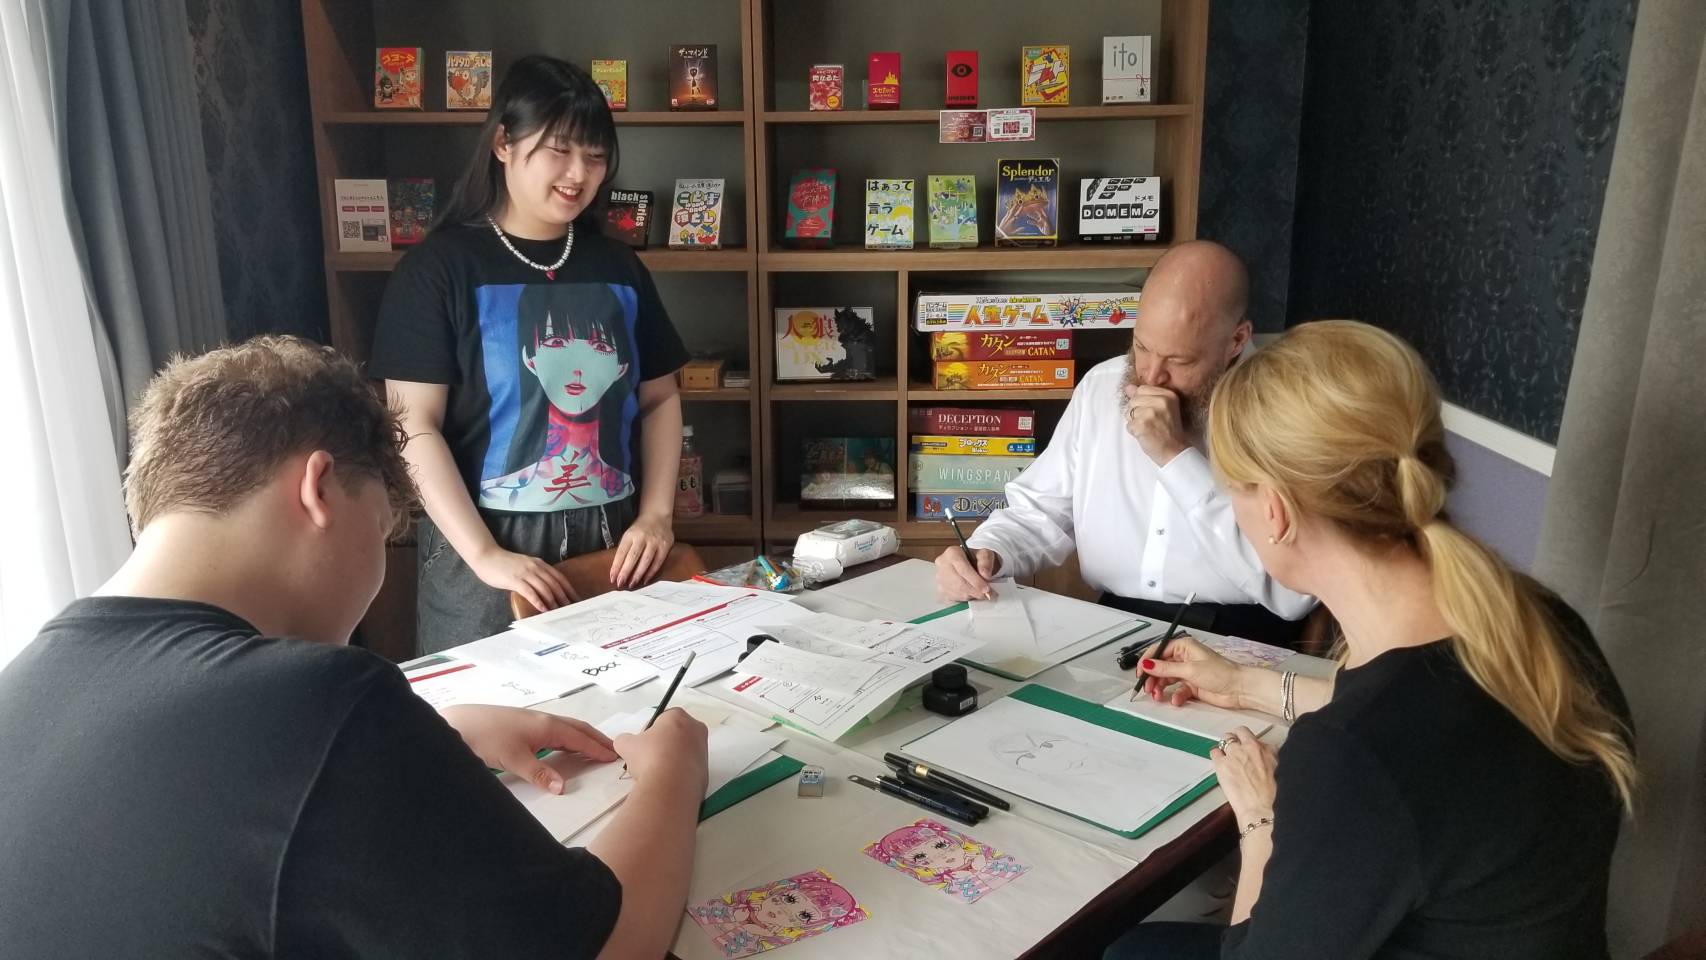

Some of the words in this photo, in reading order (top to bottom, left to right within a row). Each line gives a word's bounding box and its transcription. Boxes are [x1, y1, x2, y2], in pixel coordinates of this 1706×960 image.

[1112, 47, 1138, 71] ito
[1002, 163, 1054, 181] Splendor
[867, 180, 913, 192] はぁって
[610, 191, 640, 203] black
[635, 194, 649, 227] stories
[867, 202, 892, 214] 言う
[1083, 206, 1156, 219] DOMEMO
[867, 224, 904, 236] ゲーム
[963, 304, 1052, 326] 人生ゲーム
[981, 333, 1016, 358] カタン
[1027, 347, 1056, 356] CATAN
[978, 362, 1009, 384] カタン
[938, 414, 1002, 424] DECEPTION
[543, 450, 592, 506] 美
[939, 467, 1012, 482] WINGSPAN
